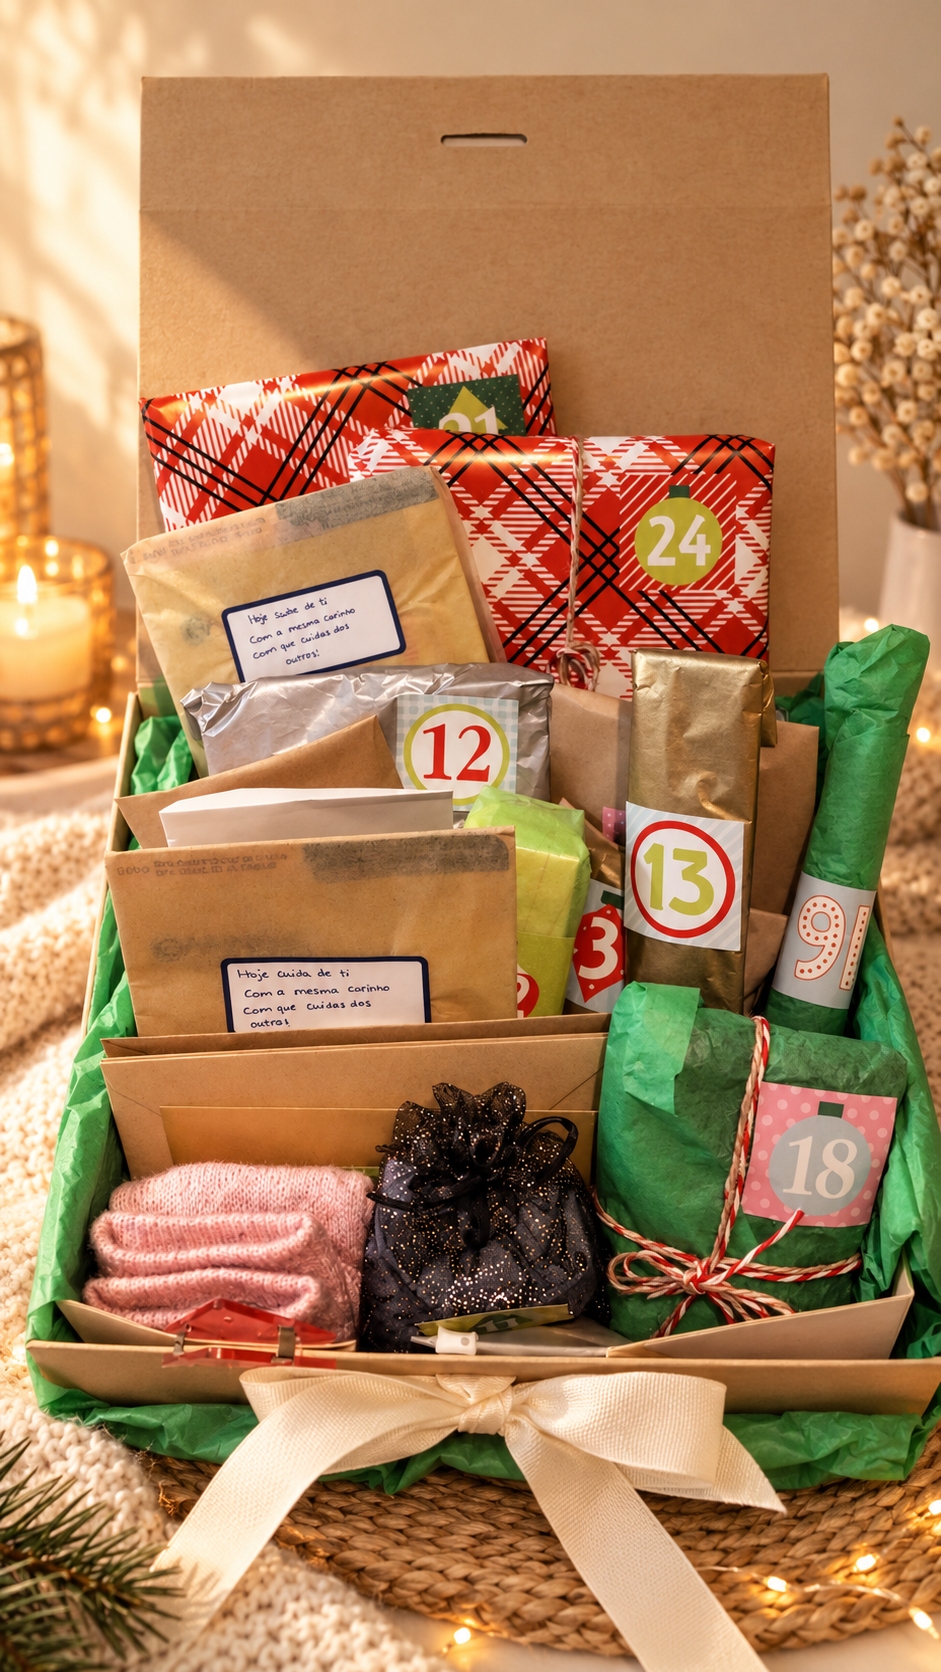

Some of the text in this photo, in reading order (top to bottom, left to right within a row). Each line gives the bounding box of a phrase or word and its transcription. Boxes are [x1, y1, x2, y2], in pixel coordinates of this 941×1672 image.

[647, 514, 711, 566] 24
[248, 614, 268, 625] Hoje
[304, 602, 316, 612] de
[318, 597, 328, 606] ti
[288, 618, 320, 632] mesma
[280, 640, 296, 653] que
[334, 622, 350, 634] dos
[423, 723, 492, 783] 12
[643, 843, 714, 916] 13
[578, 916, 618, 980] 3
[237, 968, 350, 982] Hoje cuida de ti
[294, 987, 339, 996] mesma
[348, 984, 390, 993] carinho
[276, 1004, 296, 1014] que
[350, 1000, 372, 1008] dos
[782, 1135, 858, 1199] 18
